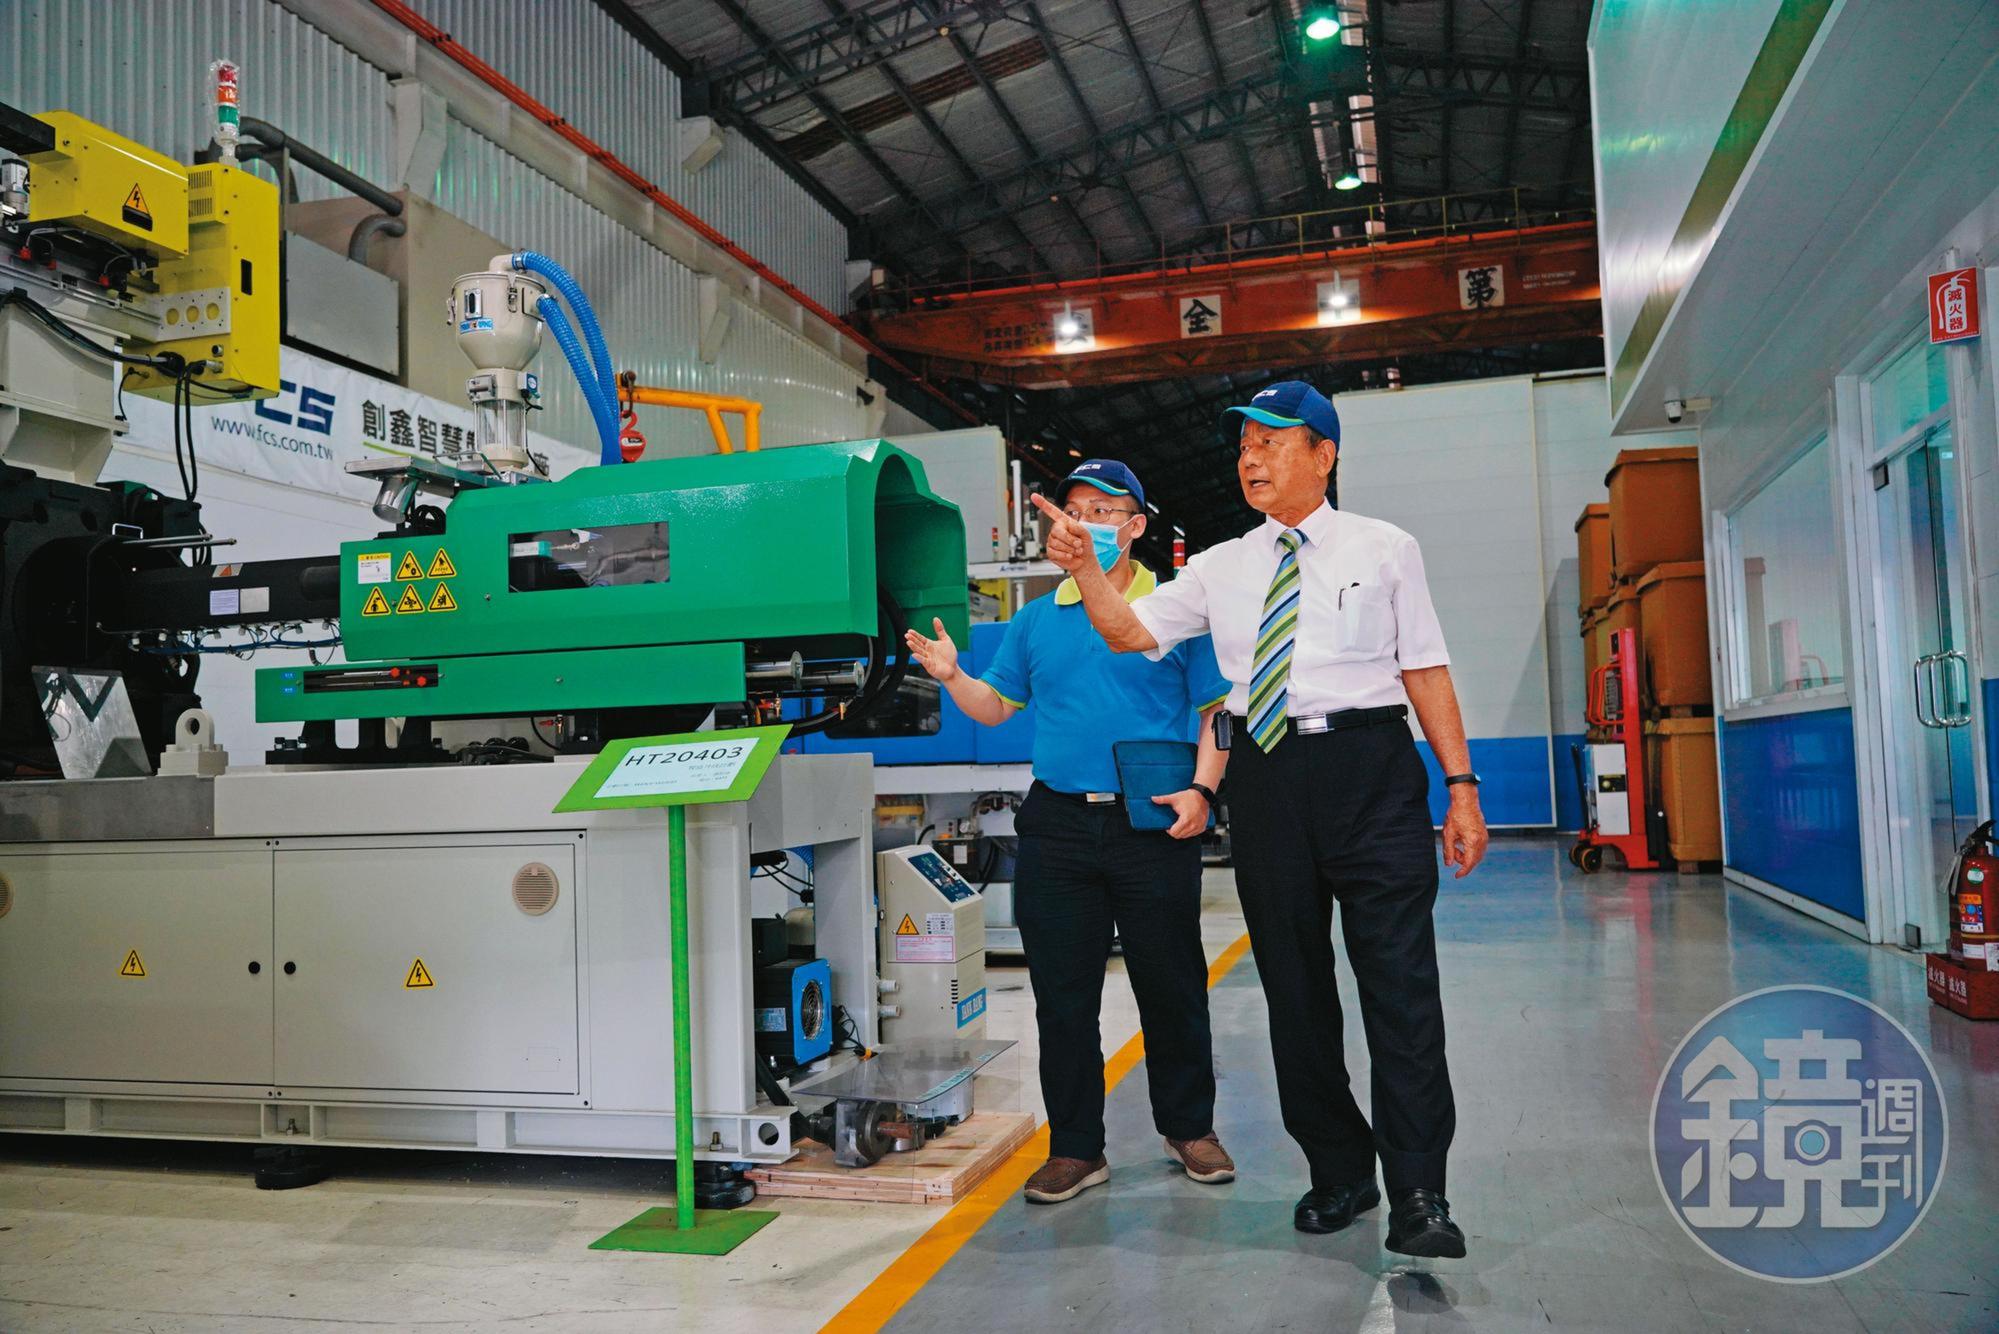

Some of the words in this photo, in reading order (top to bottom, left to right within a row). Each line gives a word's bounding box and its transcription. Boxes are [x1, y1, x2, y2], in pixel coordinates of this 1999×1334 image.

[1183, 299, 1218, 335] 全
[1465, 267, 1498, 310] 第
[1948, 288, 1963, 330] 滅火器
[255, 379, 335, 436] CS
[625, 746, 744, 767] HT20403
